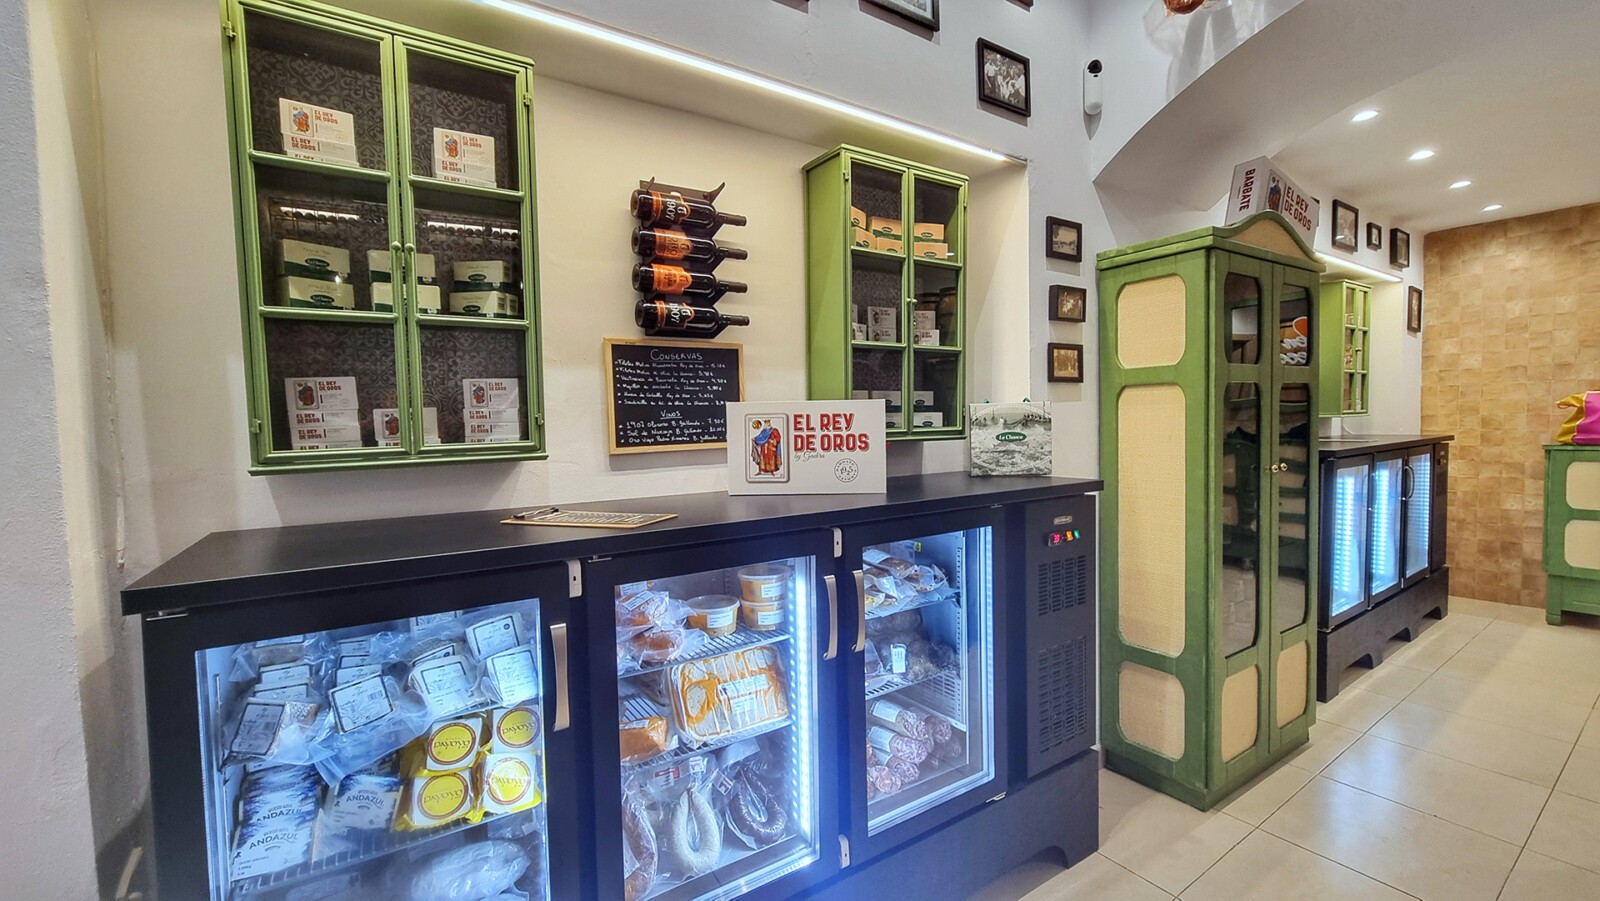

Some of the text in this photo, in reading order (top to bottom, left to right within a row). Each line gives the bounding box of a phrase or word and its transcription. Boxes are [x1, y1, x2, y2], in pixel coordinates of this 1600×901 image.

[1239, 168, 1256, 212] BARBATE
[1286, 186, 1309, 213] EL REY
[665, 198, 676, 220] 1907
[1284, 199, 1312, 231] DE OROS
[669, 302, 680, 323] 1907
[793, 413, 855, 432] EL REY
[793, 433, 870, 452] DE OROS
[346, 794, 385, 806] ANDAZUL
[249, 832, 299, 850] ANDAZUL
